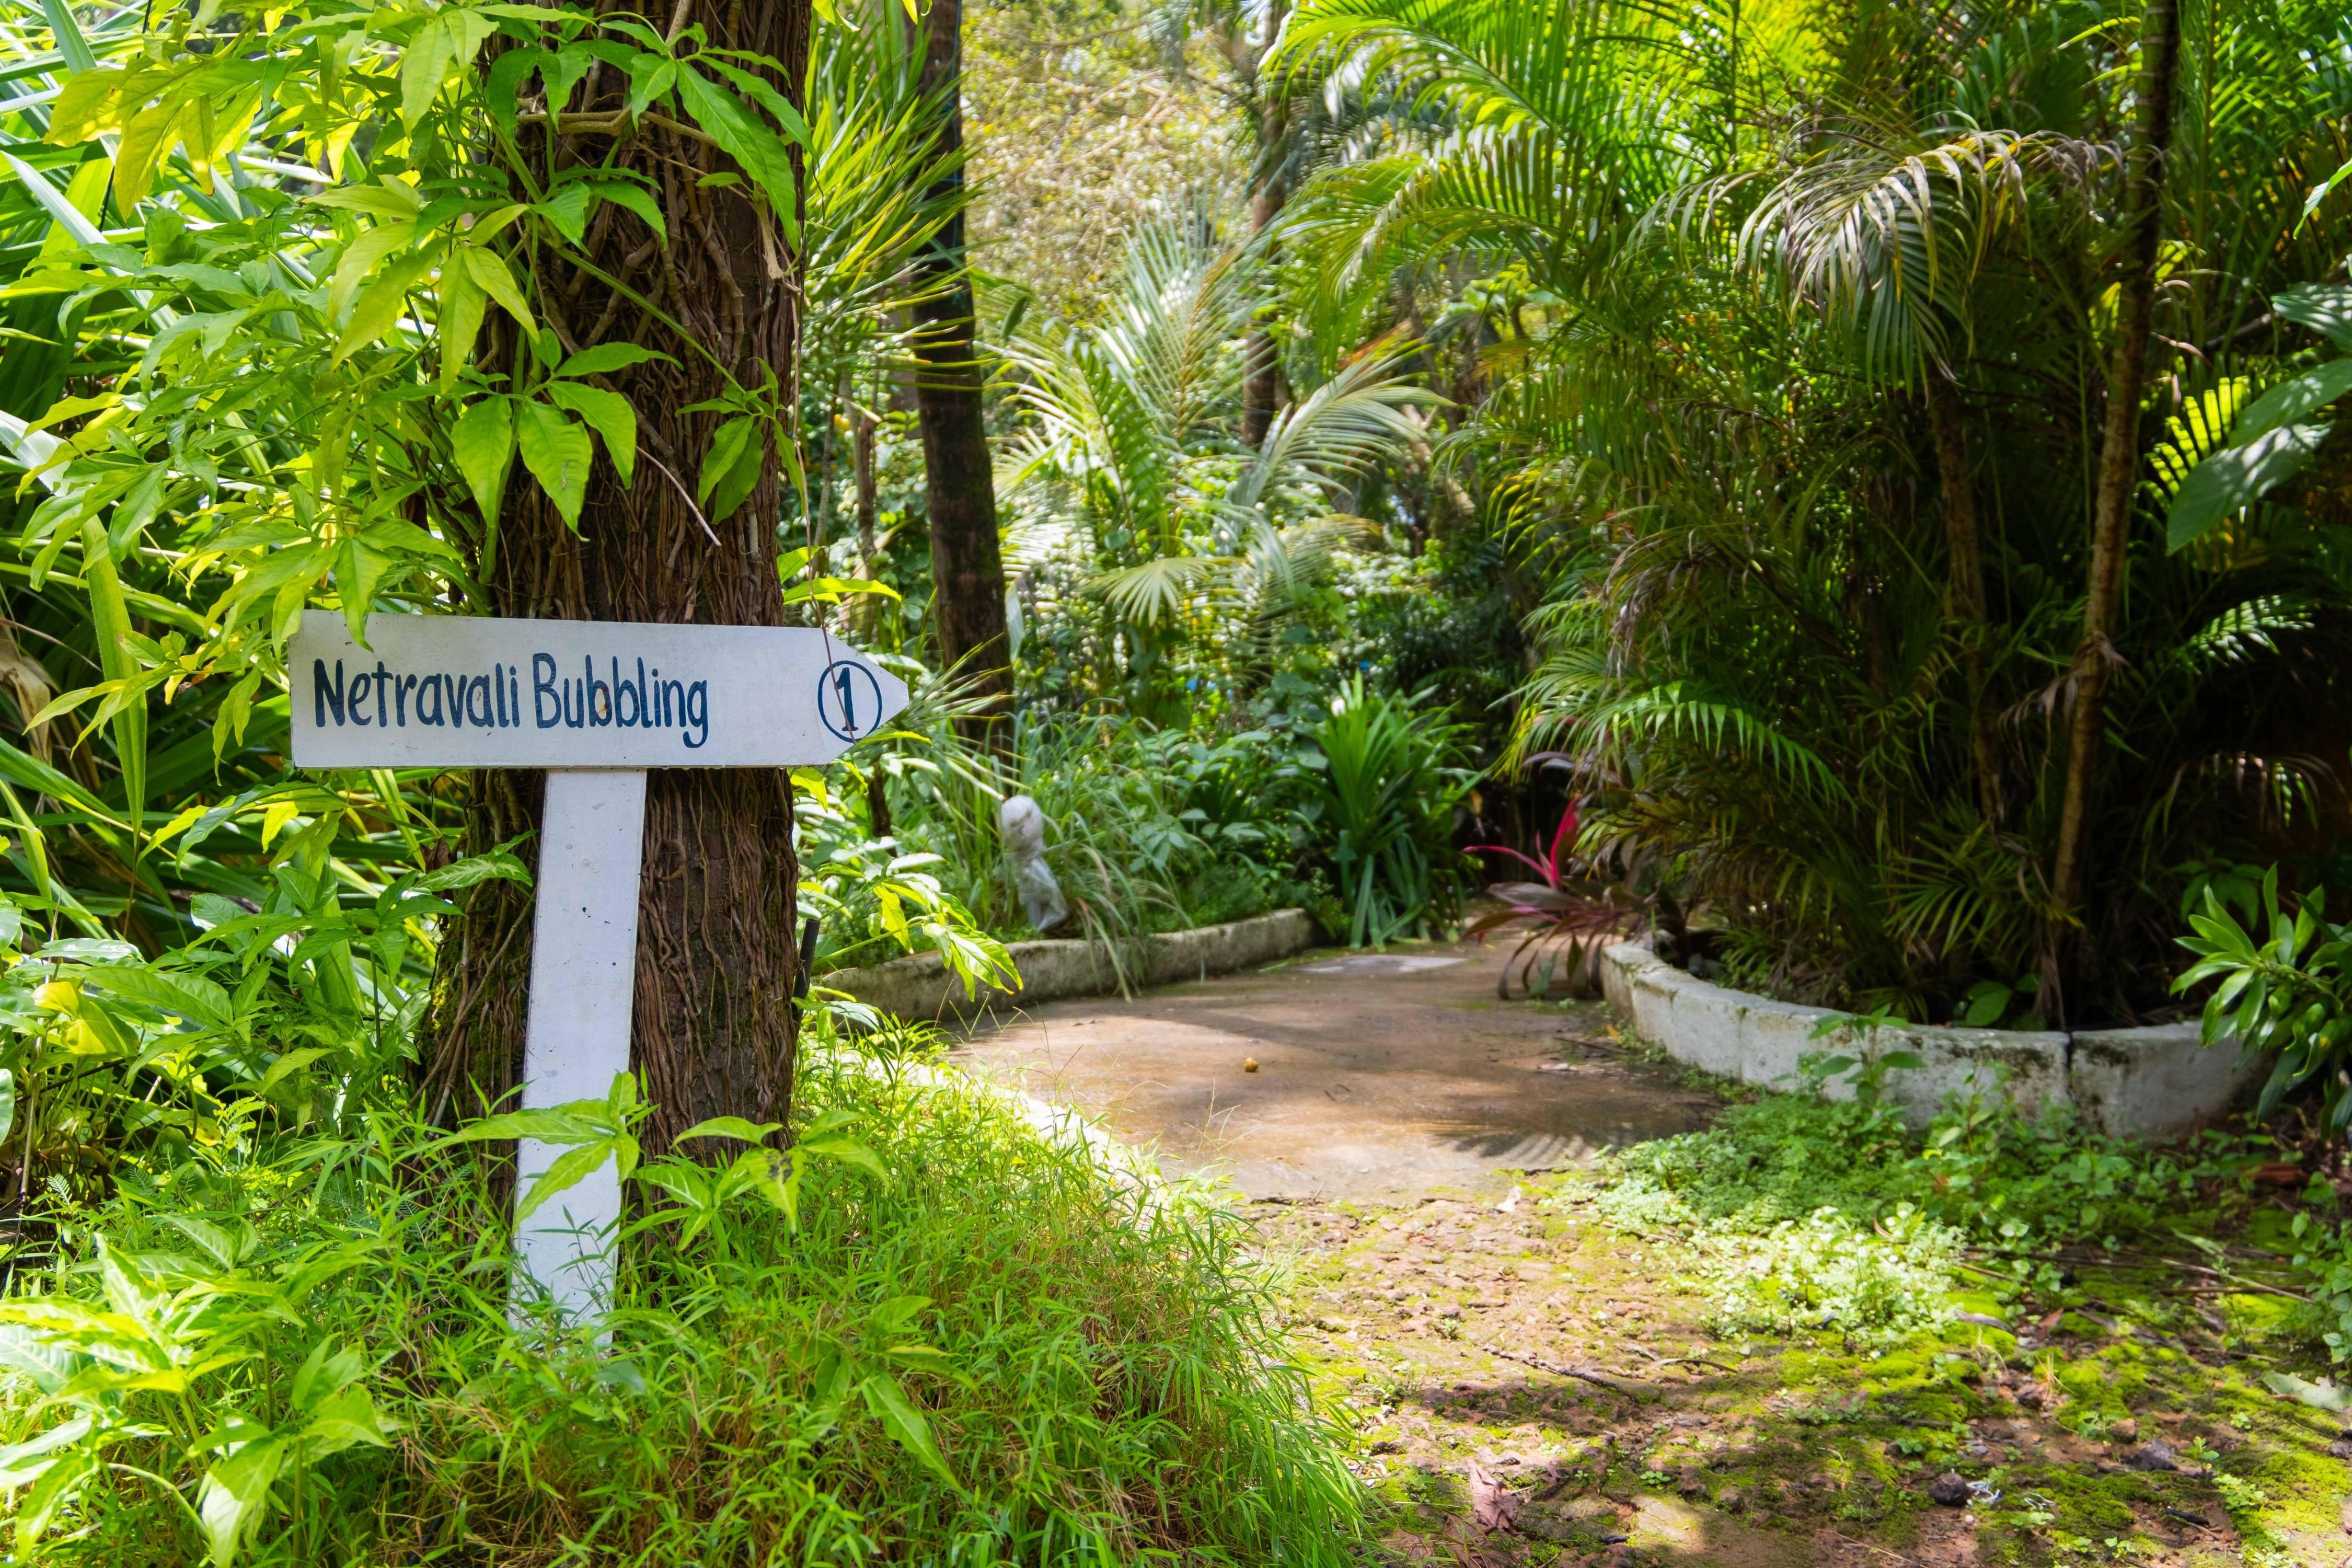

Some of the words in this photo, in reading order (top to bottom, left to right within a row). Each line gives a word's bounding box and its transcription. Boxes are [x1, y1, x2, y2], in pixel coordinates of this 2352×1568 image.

[314, 658, 520, 728] Netravali
[533, 652, 709, 748] Bubbling
[835, 667, 859, 731] 1
